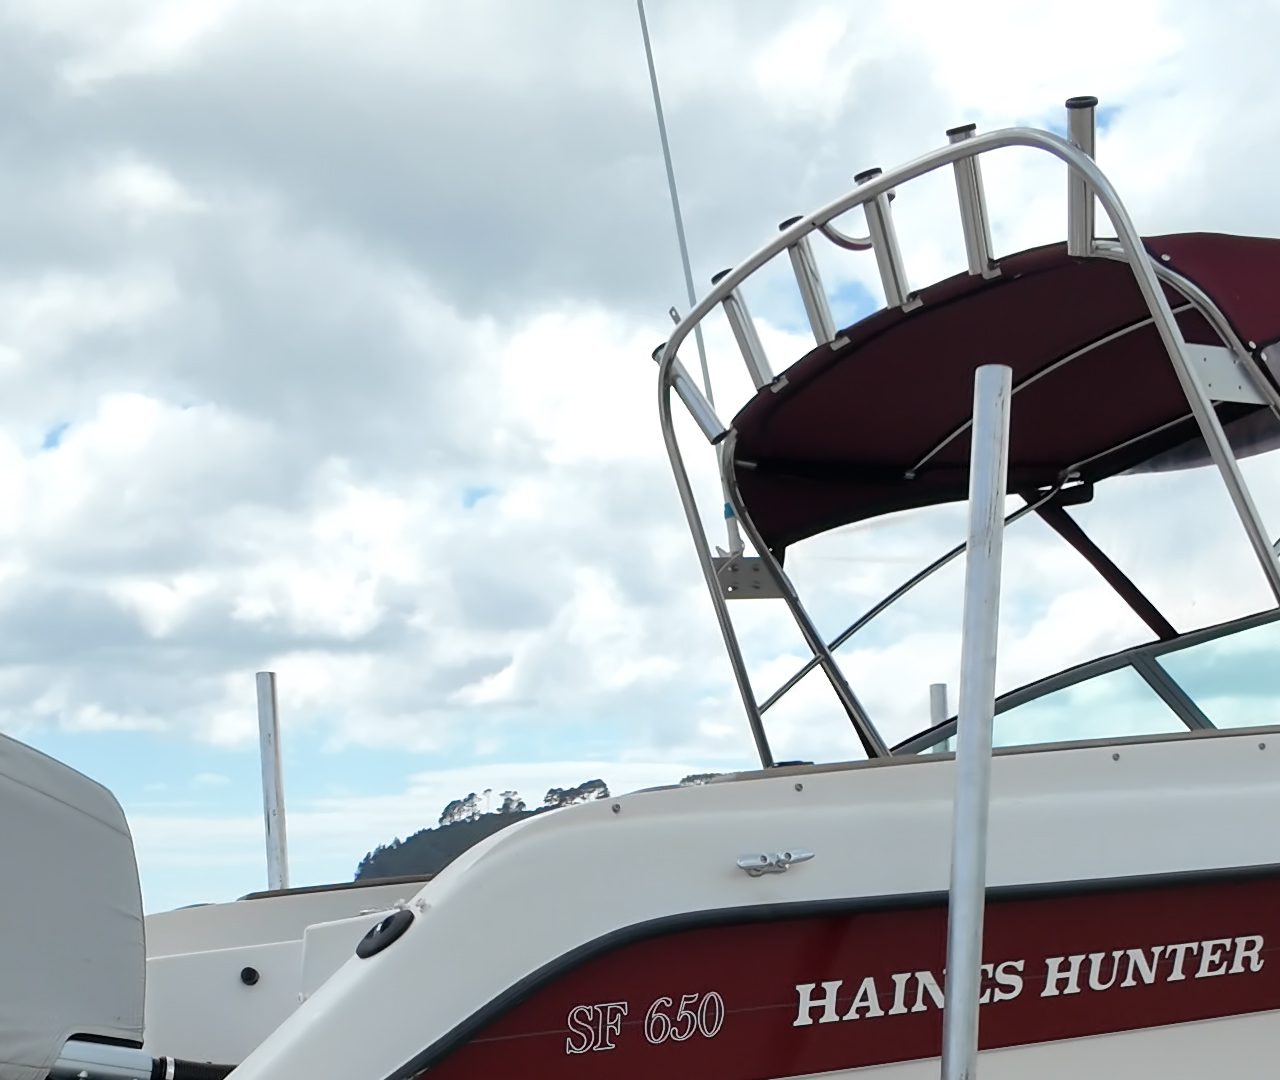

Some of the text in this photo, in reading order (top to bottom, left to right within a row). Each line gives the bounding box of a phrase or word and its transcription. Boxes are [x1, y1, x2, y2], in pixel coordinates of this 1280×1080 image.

[1040, 934, 1265, 997] HUNTER
[566, 991, 725, 1054] SF 650
